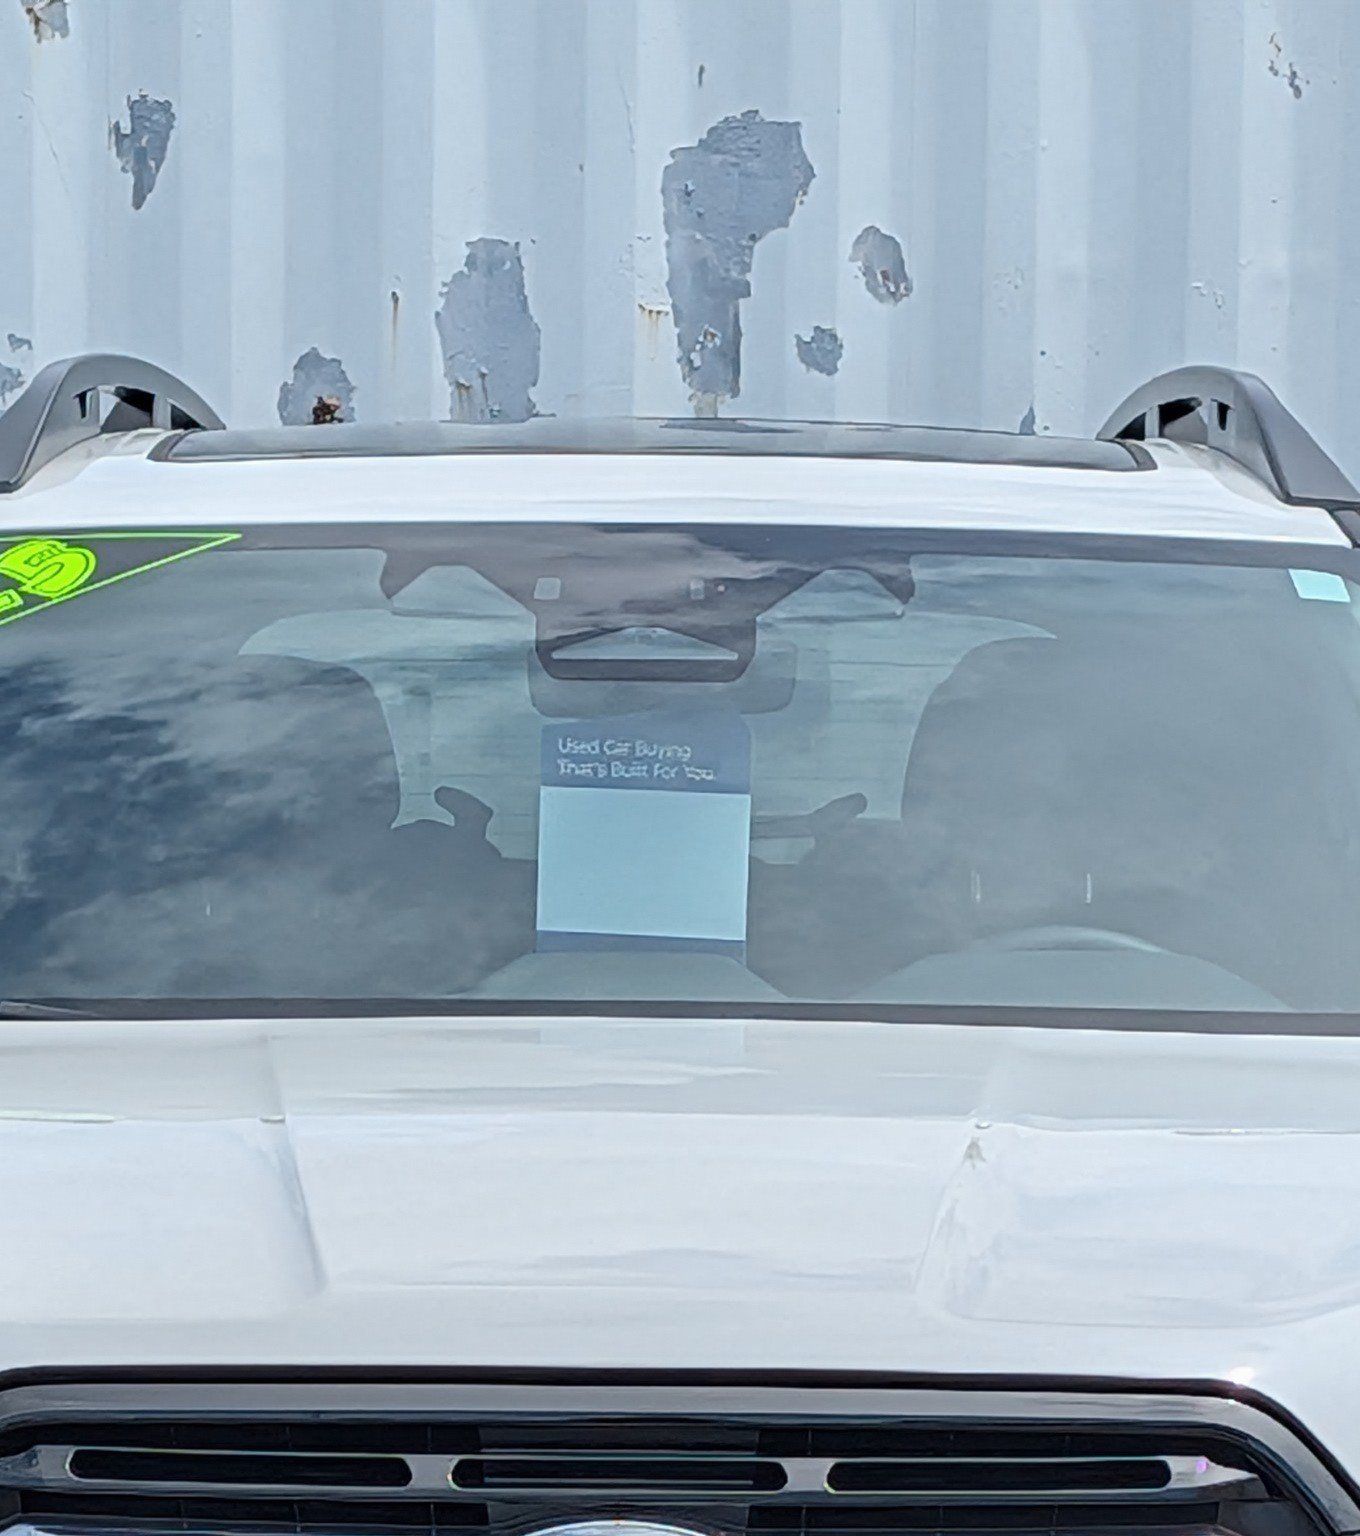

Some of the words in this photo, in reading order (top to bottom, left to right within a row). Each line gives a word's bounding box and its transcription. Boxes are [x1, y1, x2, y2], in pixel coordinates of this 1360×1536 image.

[558, 737, 600, 754] Used
[603, 739, 632, 756] Car
[634, 740, 692, 761] Buying
[610, 760, 649, 778] Built
